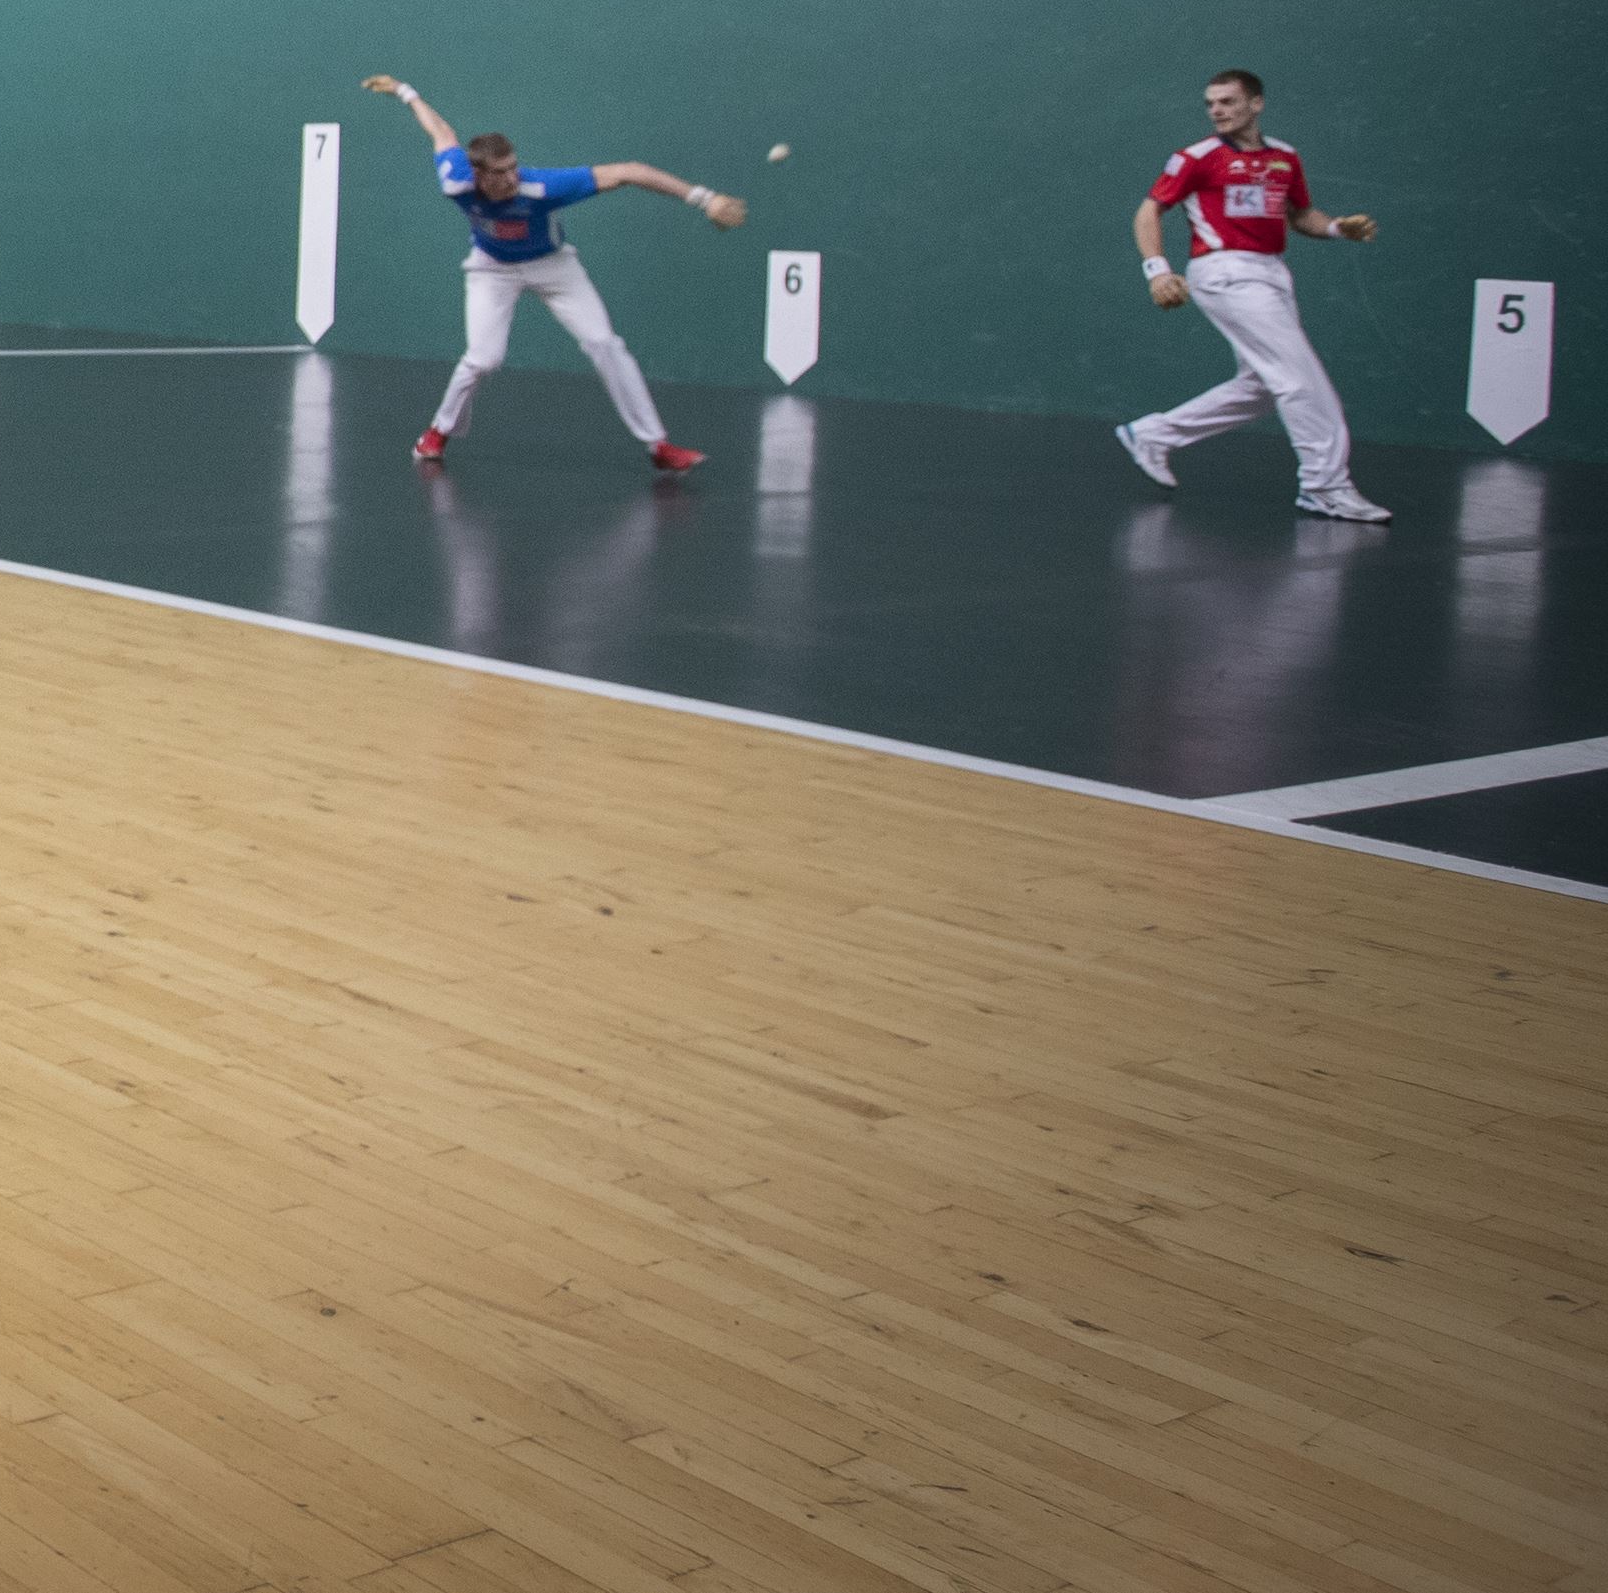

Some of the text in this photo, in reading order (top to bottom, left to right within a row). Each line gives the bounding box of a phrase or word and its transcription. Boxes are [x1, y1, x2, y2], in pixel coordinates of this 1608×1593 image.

[315, 133, 327, 160] 7
[783, 262, 803, 295] 6
[1496, 294, 1526, 334] 5
